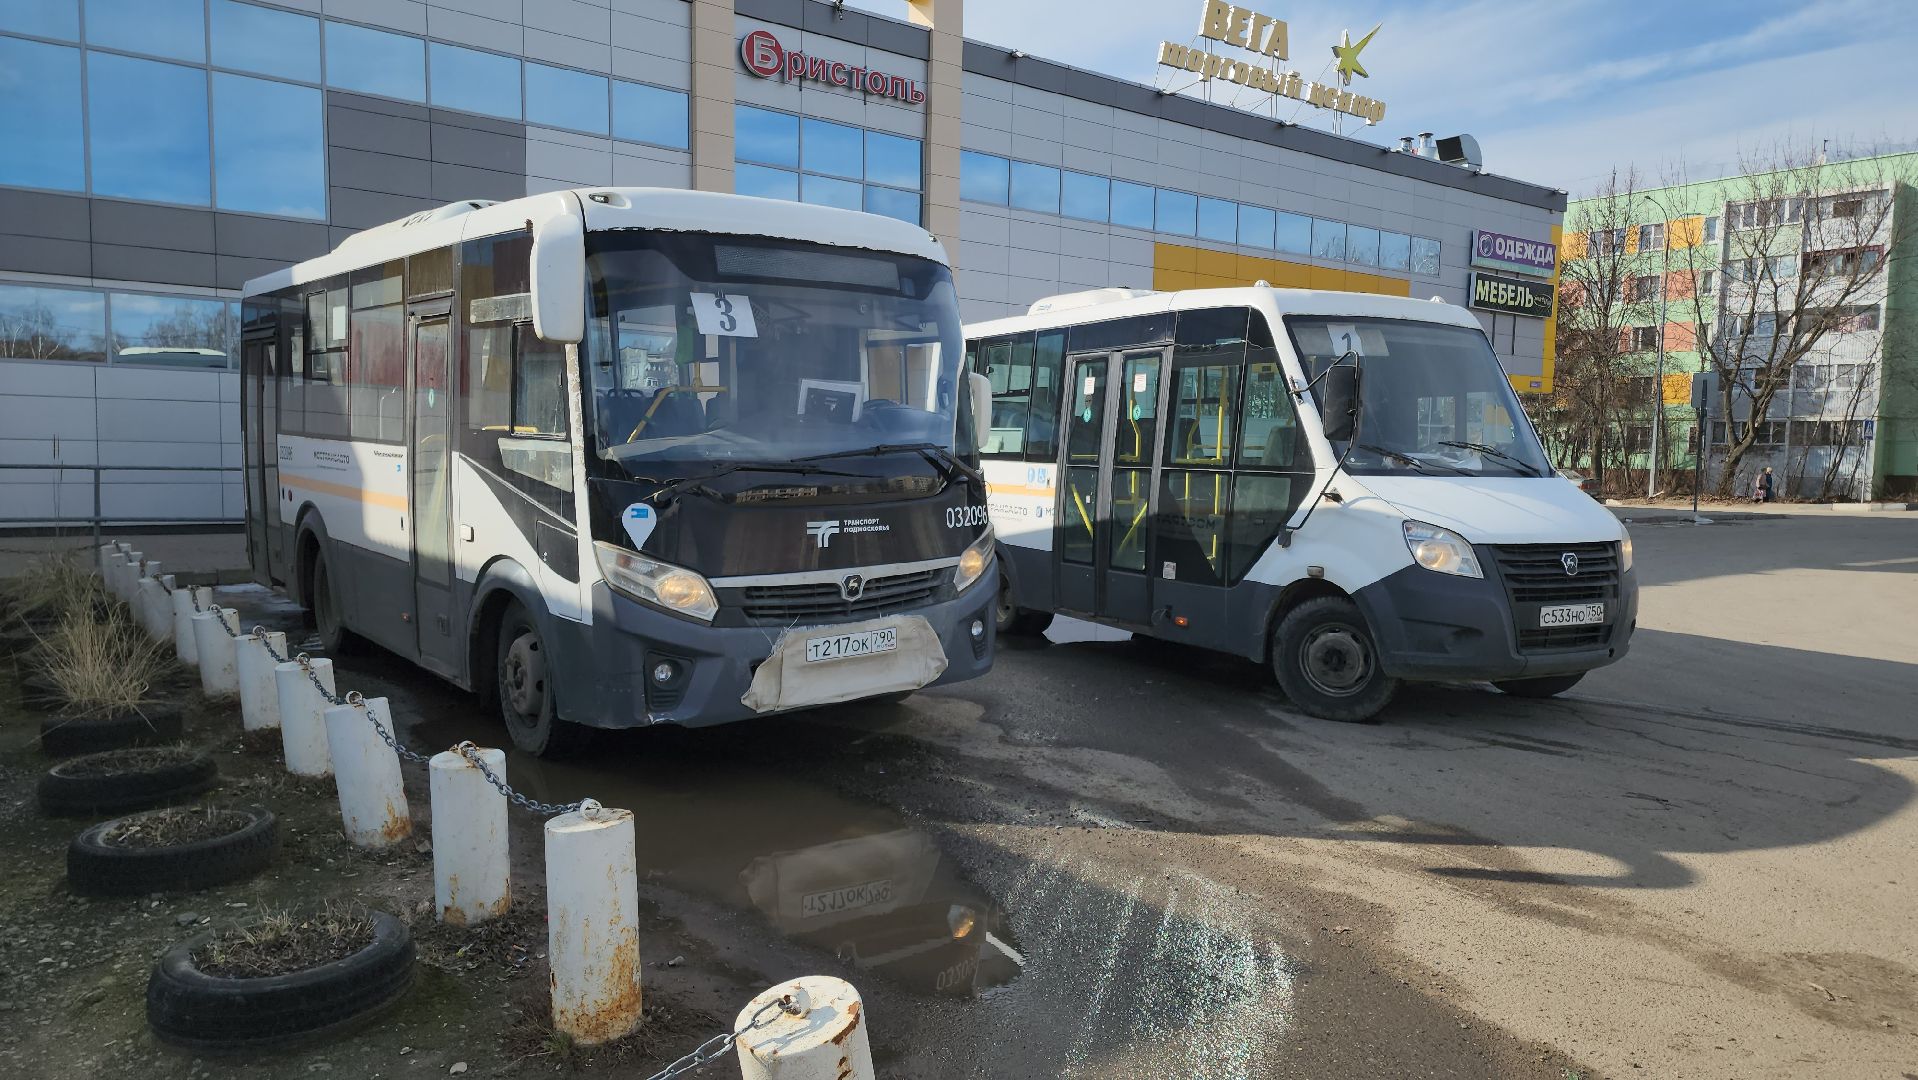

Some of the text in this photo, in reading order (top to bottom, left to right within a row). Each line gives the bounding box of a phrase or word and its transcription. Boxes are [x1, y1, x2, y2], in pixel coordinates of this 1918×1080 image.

[1198, 0, 1289, 61] ВЕГА
[743, 31, 926, 104] Бристоль
[1157, 40, 1387, 126] торговый центр
[1495, 237, 1554, 266] ОДЕЖДА
[1475, 279, 1534, 308] МЕБЕЛЬ
[714, 298, 737, 332] 3
[1341, 332, 1352, 351] 1
[843, 518, 880, 526] ТРАНСПОРТ
[946, 505, 988, 529] 032096
[1543, 605, 1602, 624] С533НО 750
[813, 630, 893, 658] Т217ОК 790
